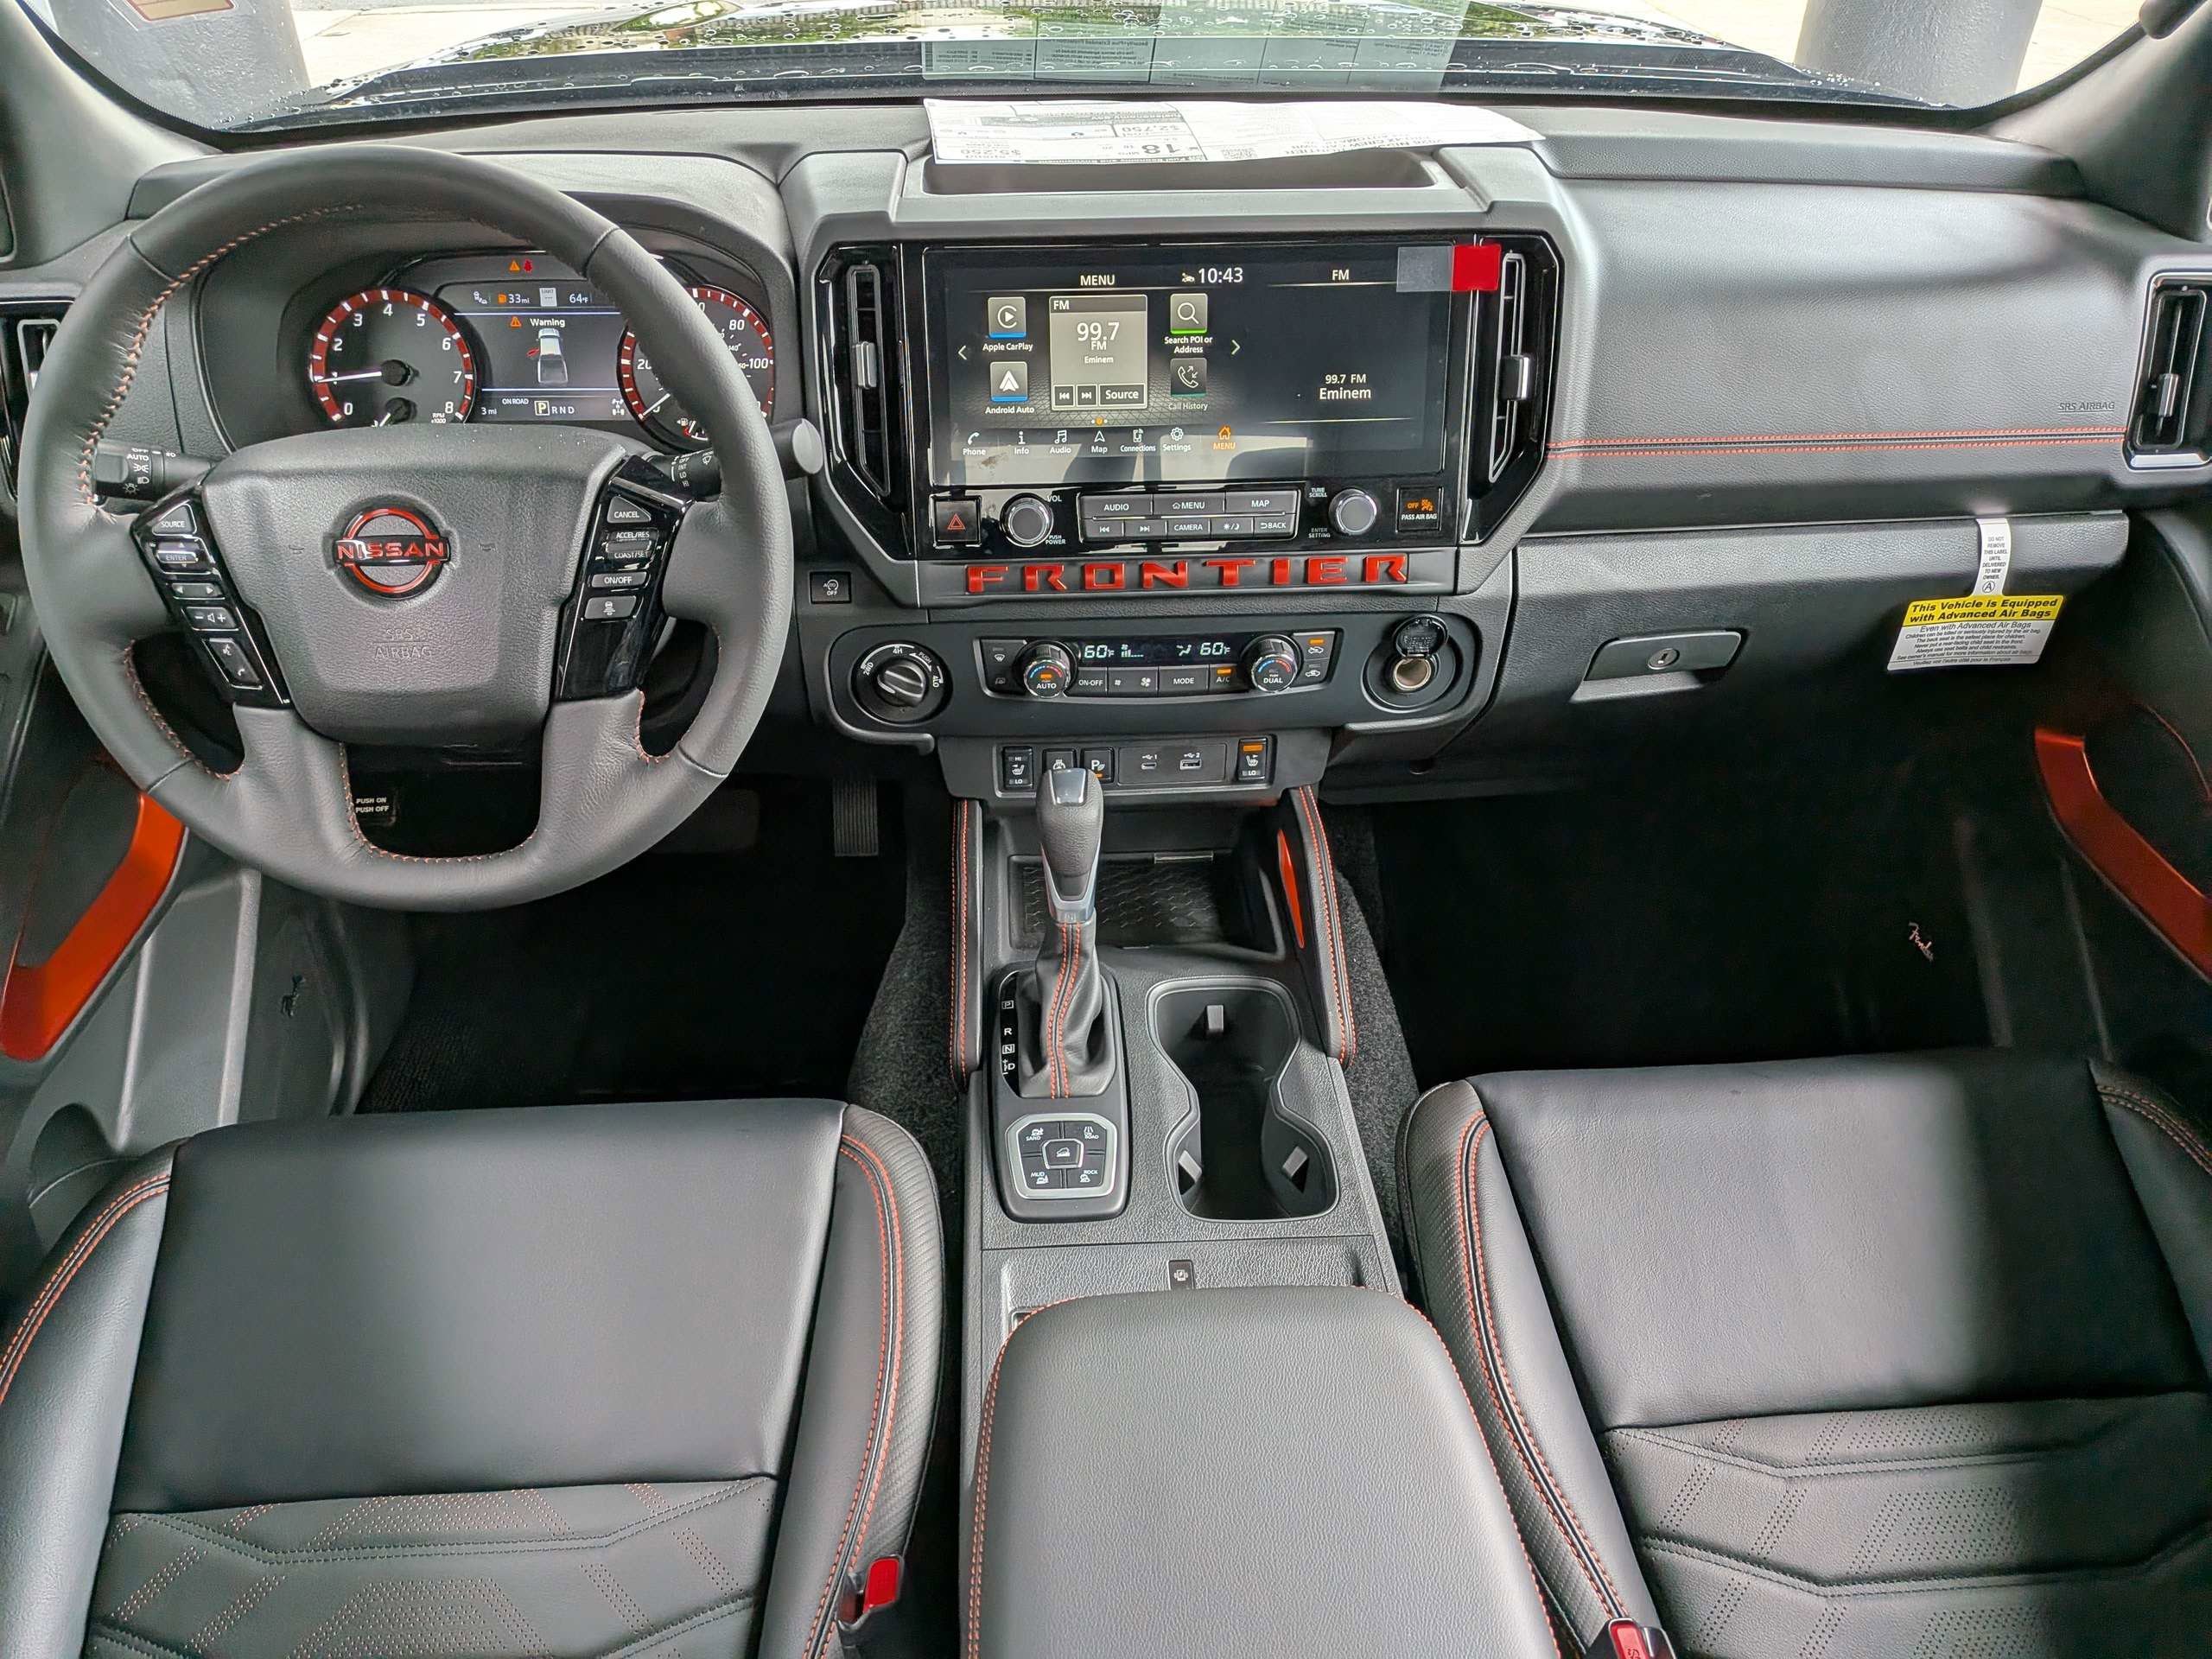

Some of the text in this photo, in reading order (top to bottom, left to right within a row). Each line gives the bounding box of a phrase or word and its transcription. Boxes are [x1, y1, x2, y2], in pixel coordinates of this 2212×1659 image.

[1141, 143, 1180, 155] 18
[1198, 267, 1243, 283] 10:43
[1332, 270, 1350, 280] FM
[1080, 275, 1115, 286] MENU
[383, 302, 394, 316] 4
[1052, 300, 1070, 311] FM
[353, 314, 363, 327] 3
[416, 313, 425, 327] 5
[530, 318, 566, 328] Warning
[729, 319, 745, 330] 80
[1077, 321, 1120, 342] 99.7
[442, 337, 451, 351] 6
[1164, 335, 1189, 344] Search
[332, 339, 342, 351] 2
[982, 342, 1033, 353] Apple CarPlay
[1090, 341, 1107, 351] FM
[1173, 346, 1204, 354] Address
[748, 358, 769, 369] 100
[1084, 356, 1114, 365] Eminem
[453, 371, 461, 384] 7
[1325, 373, 1367, 385] 99.7 FM
[1105, 389, 1139, 399] Source
[1319, 387, 1371, 400] Eminem
[344, 403, 353, 416] 0
[444, 401, 454, 414] 8
[985, 406, 1016, 415] Android
[1168, 401, 1208, 411] Call History
[2058, 401, 2115, 411] SRS AIRBAG
[1090, 445, 1108, 454] Map
[1162, 443, 1191, 453] Settings
[1213, 442, 1236, 450] MENU
[963, 448, 987, 456] Phone
[1103, 503, 1130, 512] AUDIO
[1180, 501, 1205, 510] MENU
[1251, 499, 1270, 508] MAP
[161, 520, 186, 529] SOURCE
[615, 531, 650, 539] ACCEL/RES
[337, 542, 446, 560] NISSAN
[965, 553, 1408, 594] FRONTIER
[603, 575, 632, 584] ON/OFF
[1912, 599, 2058, 613] This Vehicle is Equipped
[1910, 613, 1934, 623] with
[1937, 610, 1996, 620] Advanced
[2020, 608, 2051, 619] Bags
[374, 645, 432, 660] AIRBAG
[862, 661, 874, 676] 2WD
[1078, 678, 1103, 687] ON-OFF
[1173, 677, 1194, 686] MODE
[1216, 674, 1230, 684] A/C
[356, 797, 375, 805] PUSH
[1004, 1027, 1013, 1036] R
